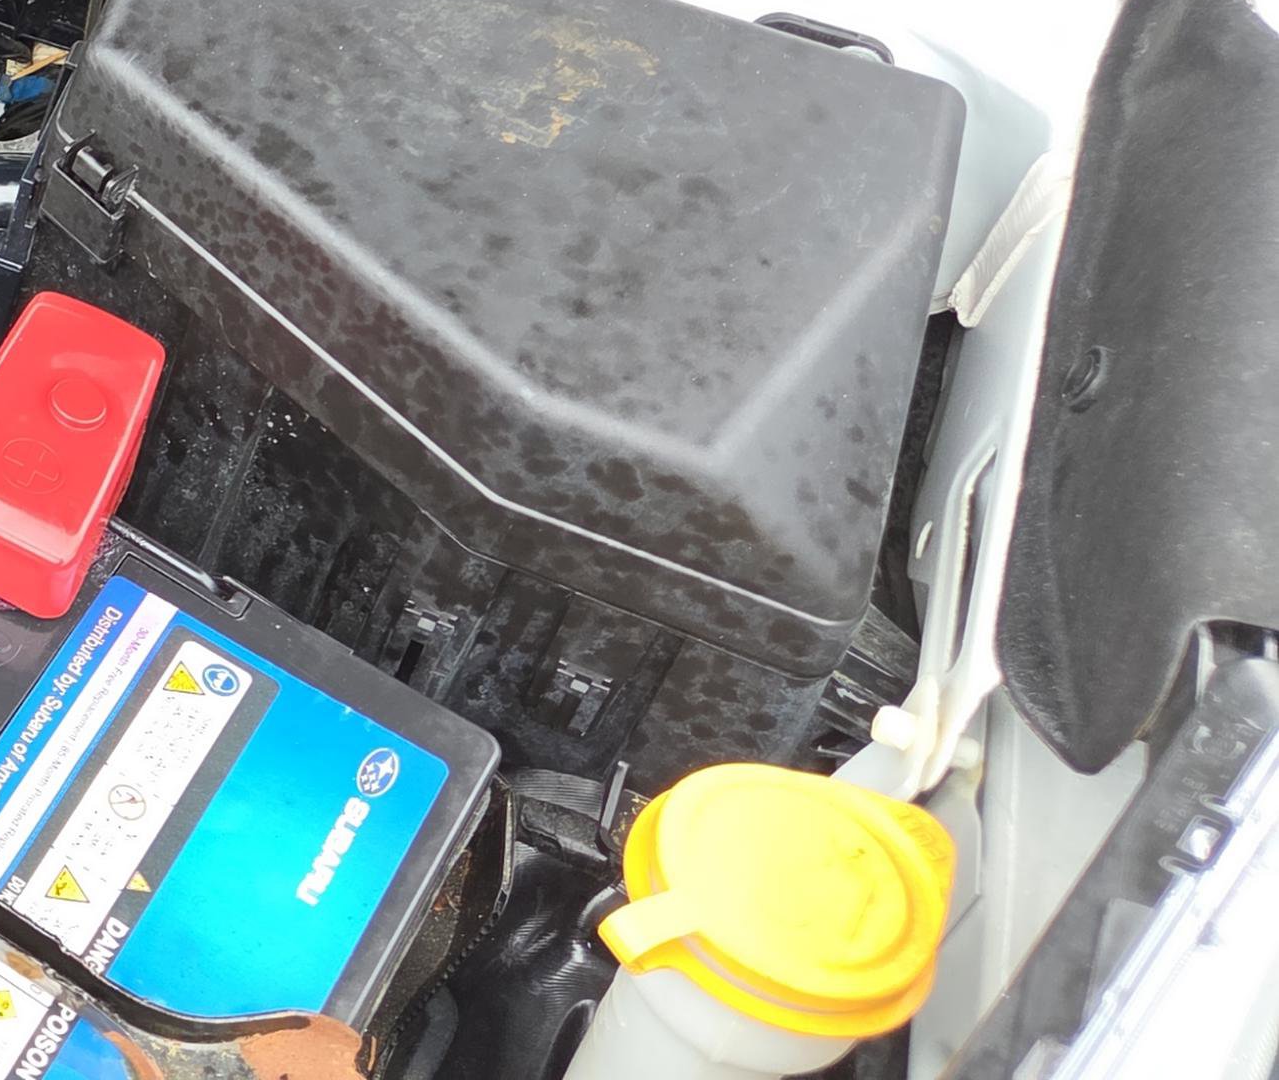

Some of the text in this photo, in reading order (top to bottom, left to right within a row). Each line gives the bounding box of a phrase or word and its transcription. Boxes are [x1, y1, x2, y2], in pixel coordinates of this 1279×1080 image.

[74, 606, 124, 672] Distributed
[117, 627, 150, 667] 30-Month
[52, 672, 78, 696] by:
[105, 667, 123, 686] Free
[20, 695, 63, 744] Subaru
[70, 687, 109, 742] Replacement
[10, 742, 28, 762] of
[296, 797, 370, 906] SUBARU
[79, 915, 129, 974] DANG
[14, 1001, 78, 1080] POISON
